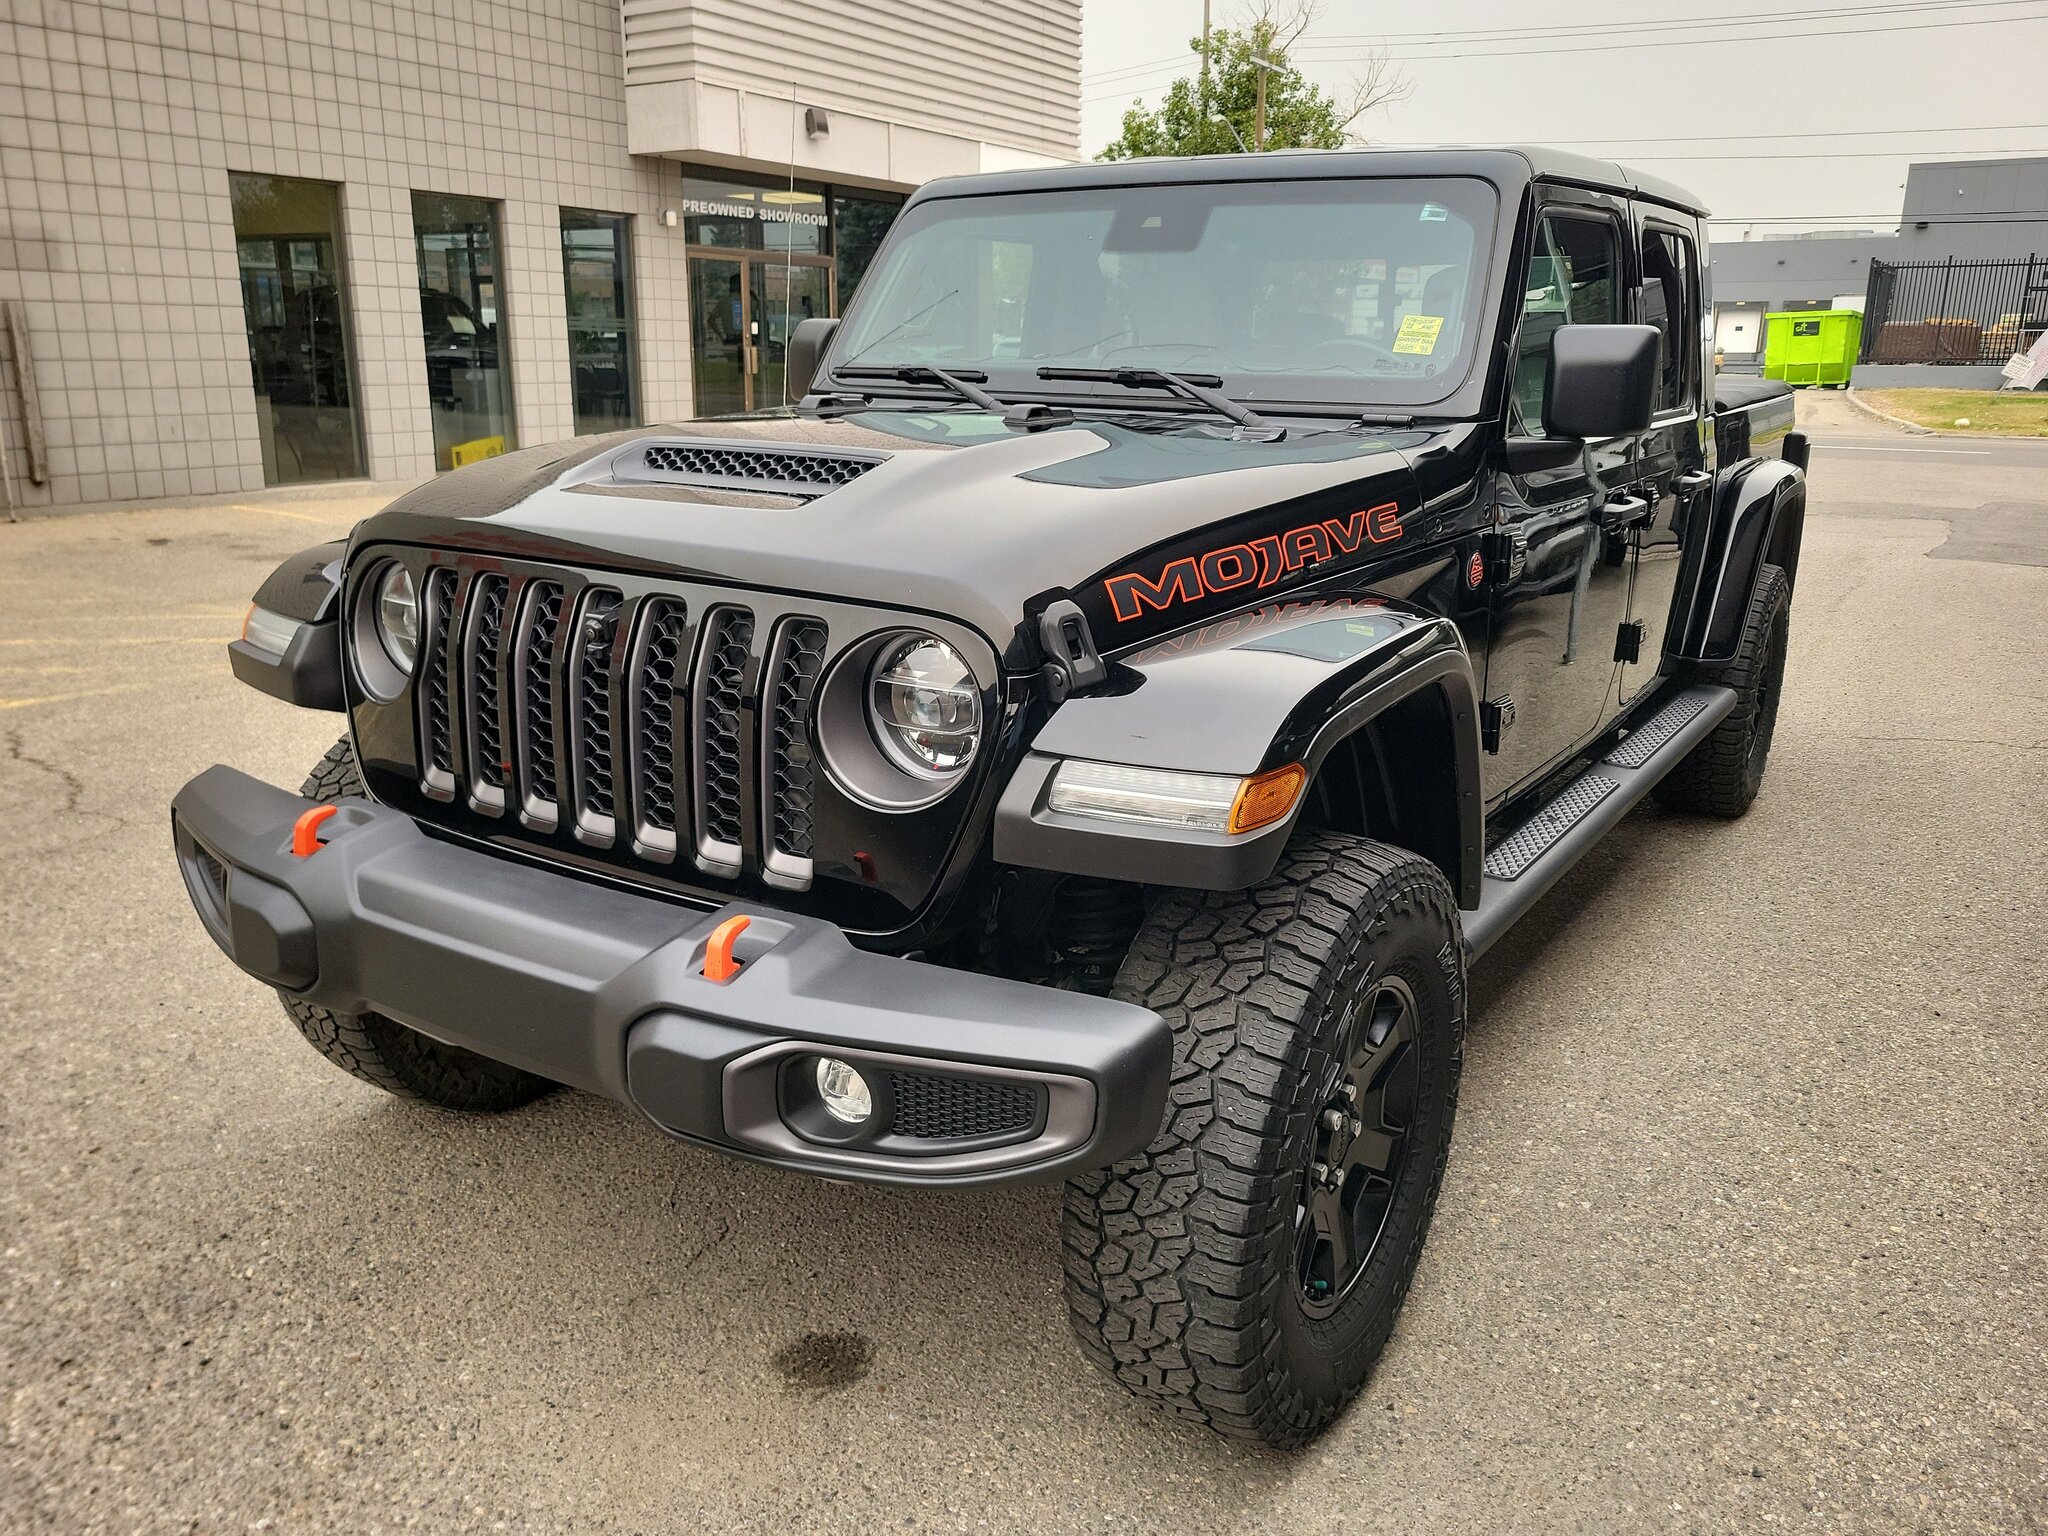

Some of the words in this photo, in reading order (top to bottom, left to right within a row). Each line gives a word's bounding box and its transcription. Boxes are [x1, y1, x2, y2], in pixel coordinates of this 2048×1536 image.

[683, 199, 754, 219] PREOWNED
[759, 209, 828, 227] SHOWROOM
[1104, 502, 1402, 622] MOJAVE
